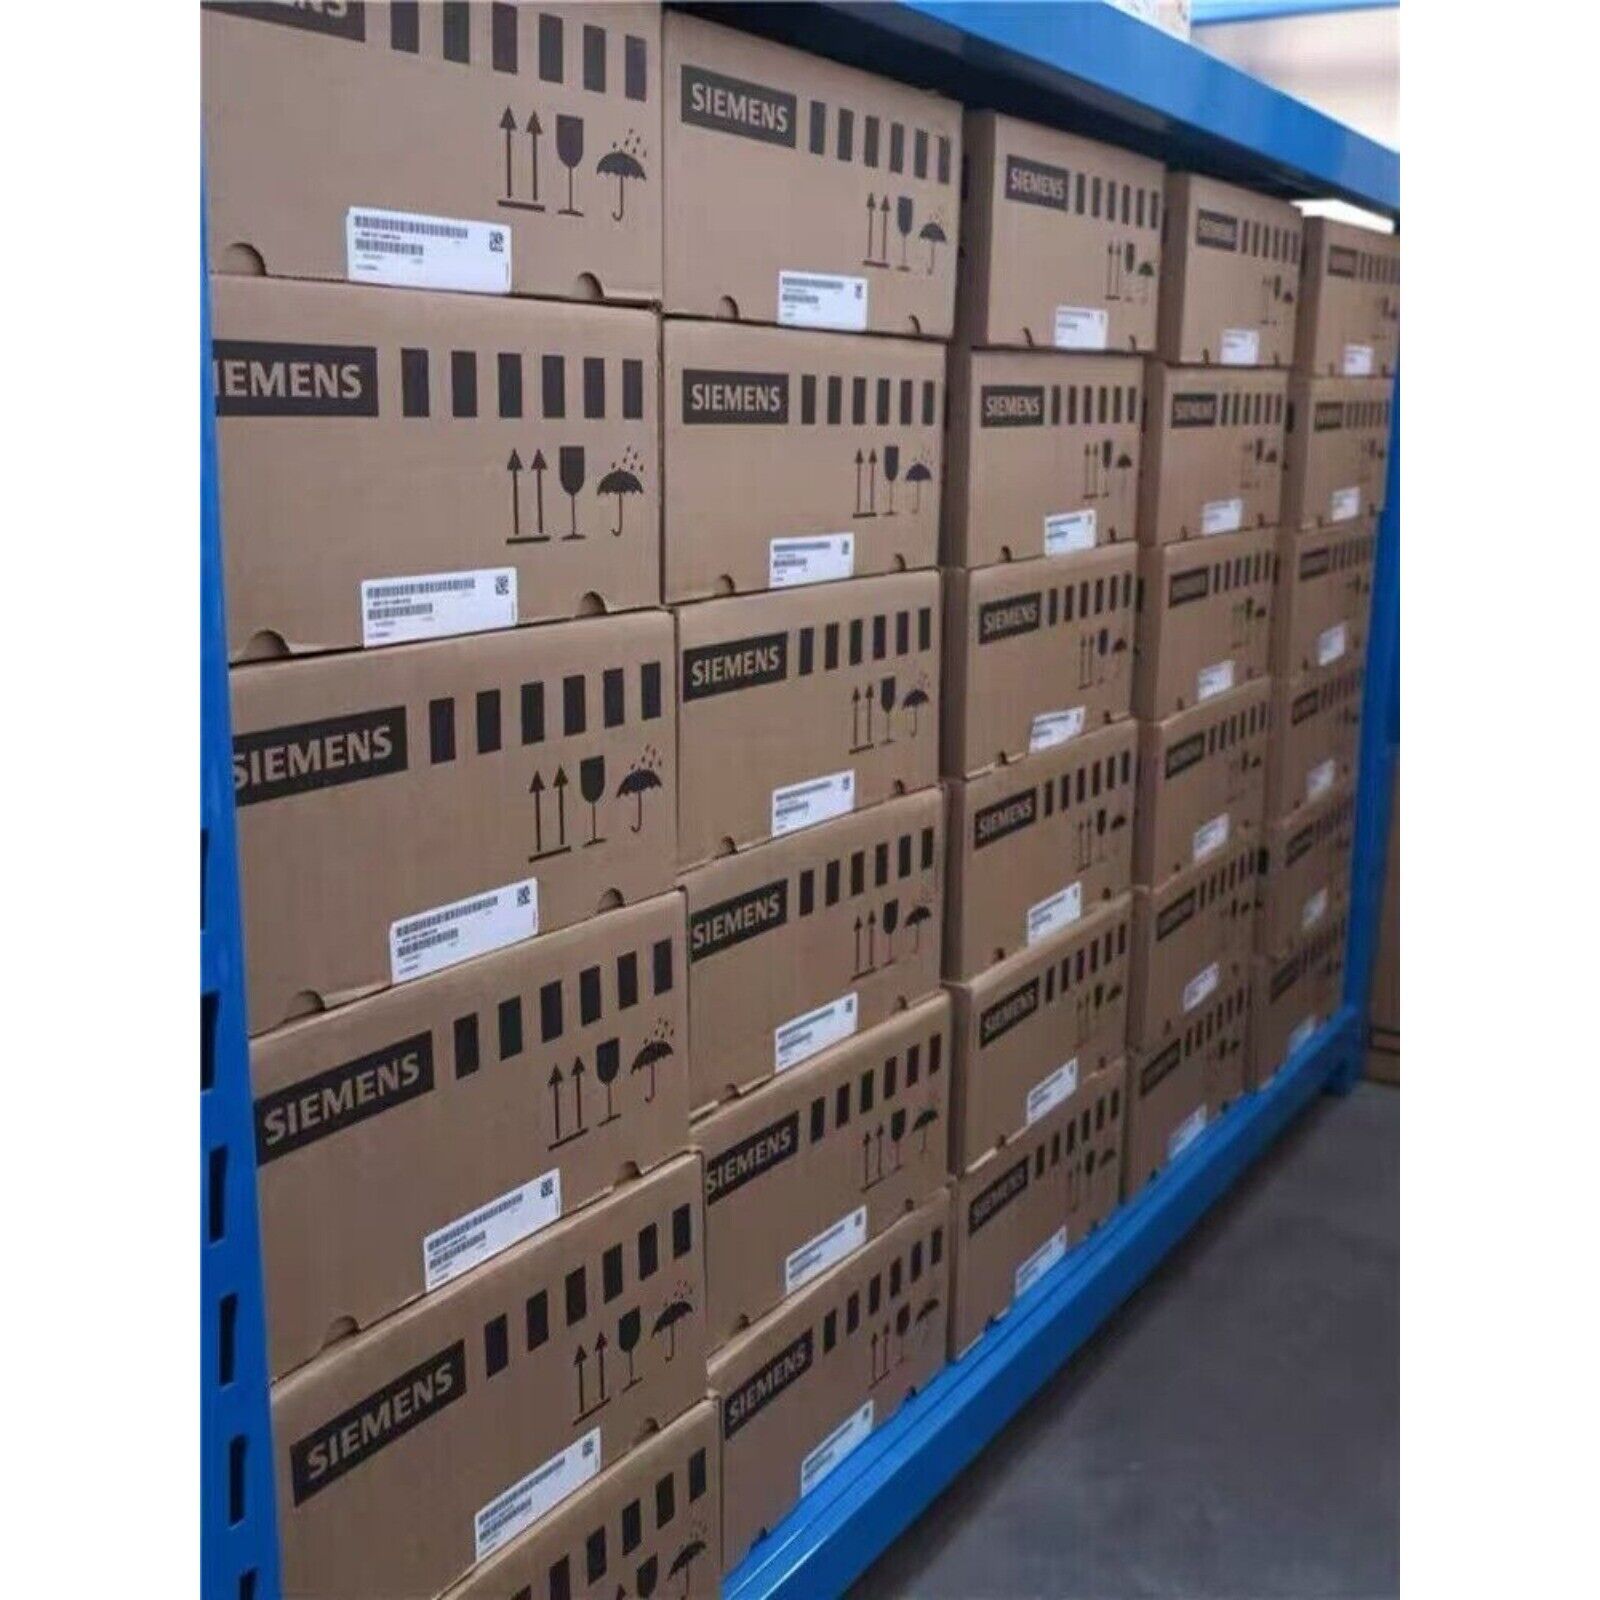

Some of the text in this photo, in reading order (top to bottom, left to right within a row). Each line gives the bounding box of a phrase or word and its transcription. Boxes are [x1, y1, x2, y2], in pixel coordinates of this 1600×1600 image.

[692, 82, 788, 133] SIEMENS
[692, 383, 781, 412] SIEMENS
[986, 395, 1039, 417] SIEMENS
[691, 645, 780, 687] SIEMENS
[232, 725, 393, 790] SIEMENS
[692, 893, 780, 950] SIEMENS
[264, 1052, 420, 1146] SIEMENS
[704, 1126, 791, 1194] SIEMENS
[729, 1341, 805, 1426] SIEMENS
[307, 1362, 454, 1479] SIEMENS
